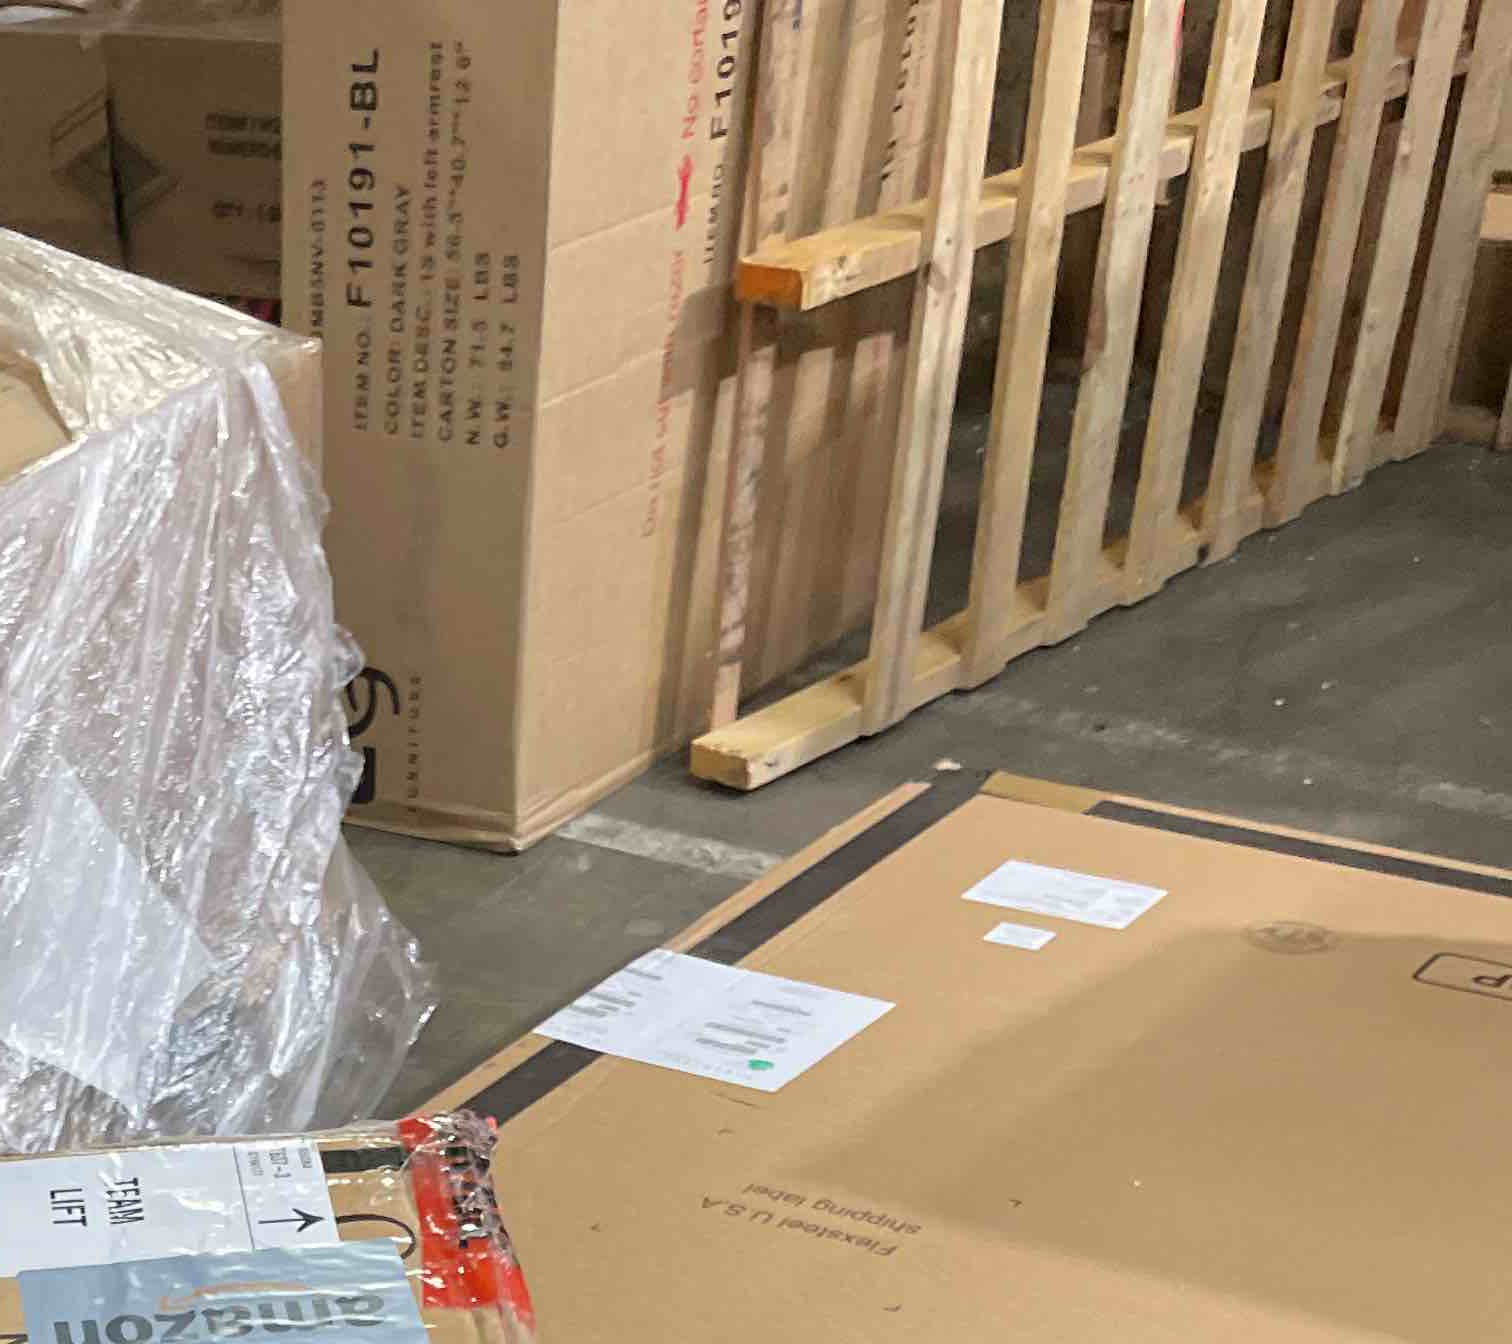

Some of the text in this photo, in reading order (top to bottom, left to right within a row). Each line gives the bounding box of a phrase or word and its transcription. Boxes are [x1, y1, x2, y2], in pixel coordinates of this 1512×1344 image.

[346, 47, 380, 308] F10191-BL
[391, 183, 411, 255] GRAY
[49, 1187, 88, 1227] LIFT
[104, 1176, 146, 1226] TEAM
[741, 1182, 922, 1235] shipping label
